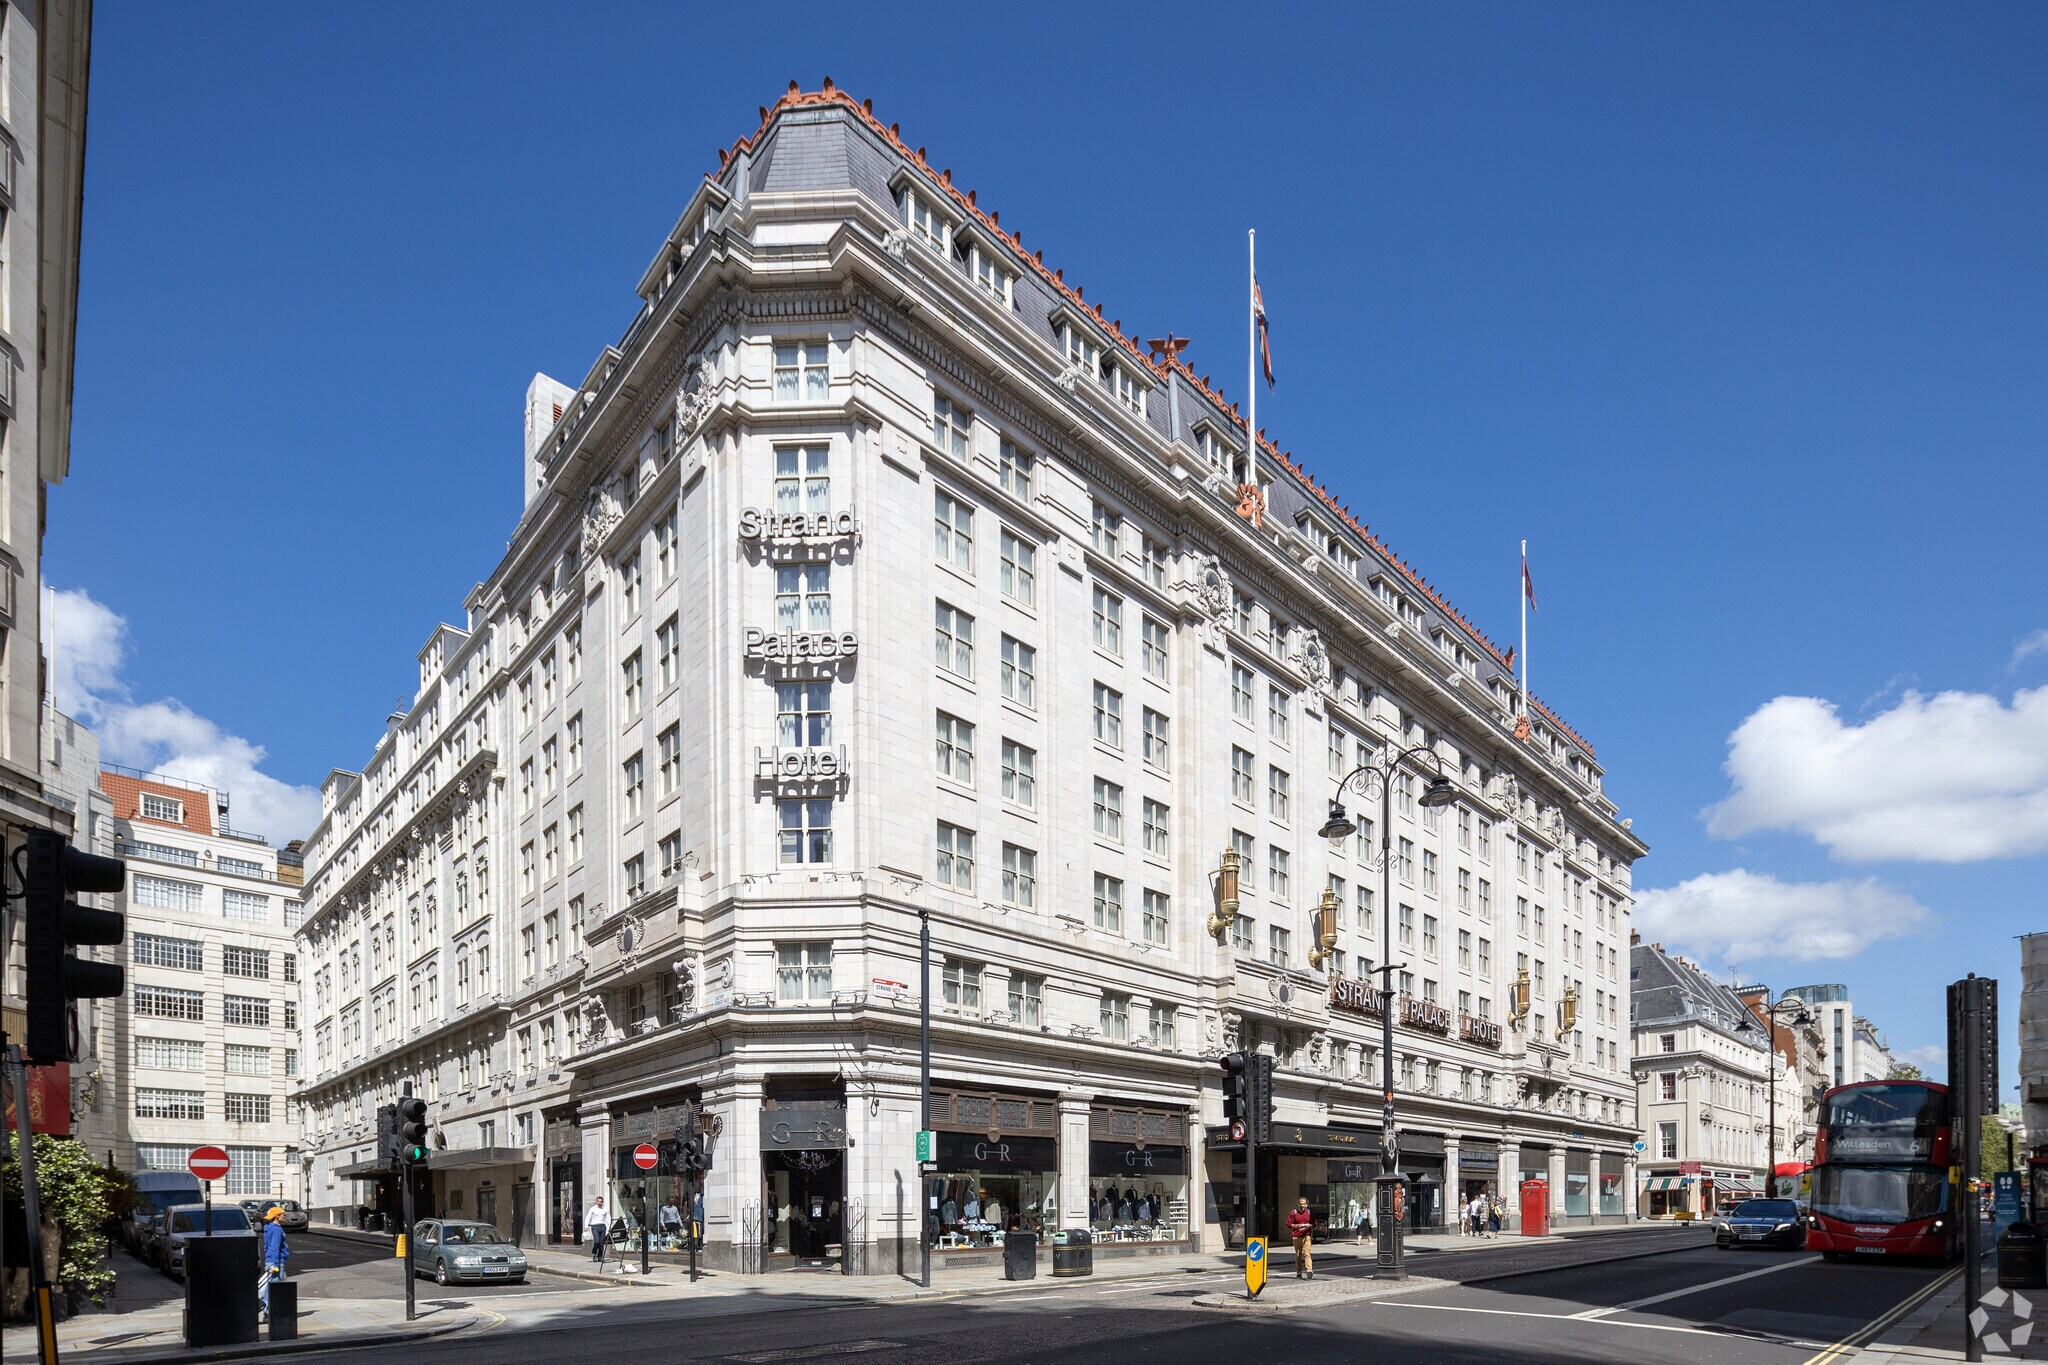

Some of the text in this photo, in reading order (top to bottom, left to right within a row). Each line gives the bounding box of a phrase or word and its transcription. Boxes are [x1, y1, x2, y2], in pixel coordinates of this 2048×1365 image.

[738, 503, 856, 539] Strand
[741, 626, 859, 657] Palace
[754, 744, 847, 777] Hotel
[875, 984, 892, 992] STRAND
[1337, 980, 1502, 1042] STRAN PALACE HOTEL
[1836, 1139, 1920, 1152] Willesden 6
[1854, 1226, 1890, 1234] Metroline
